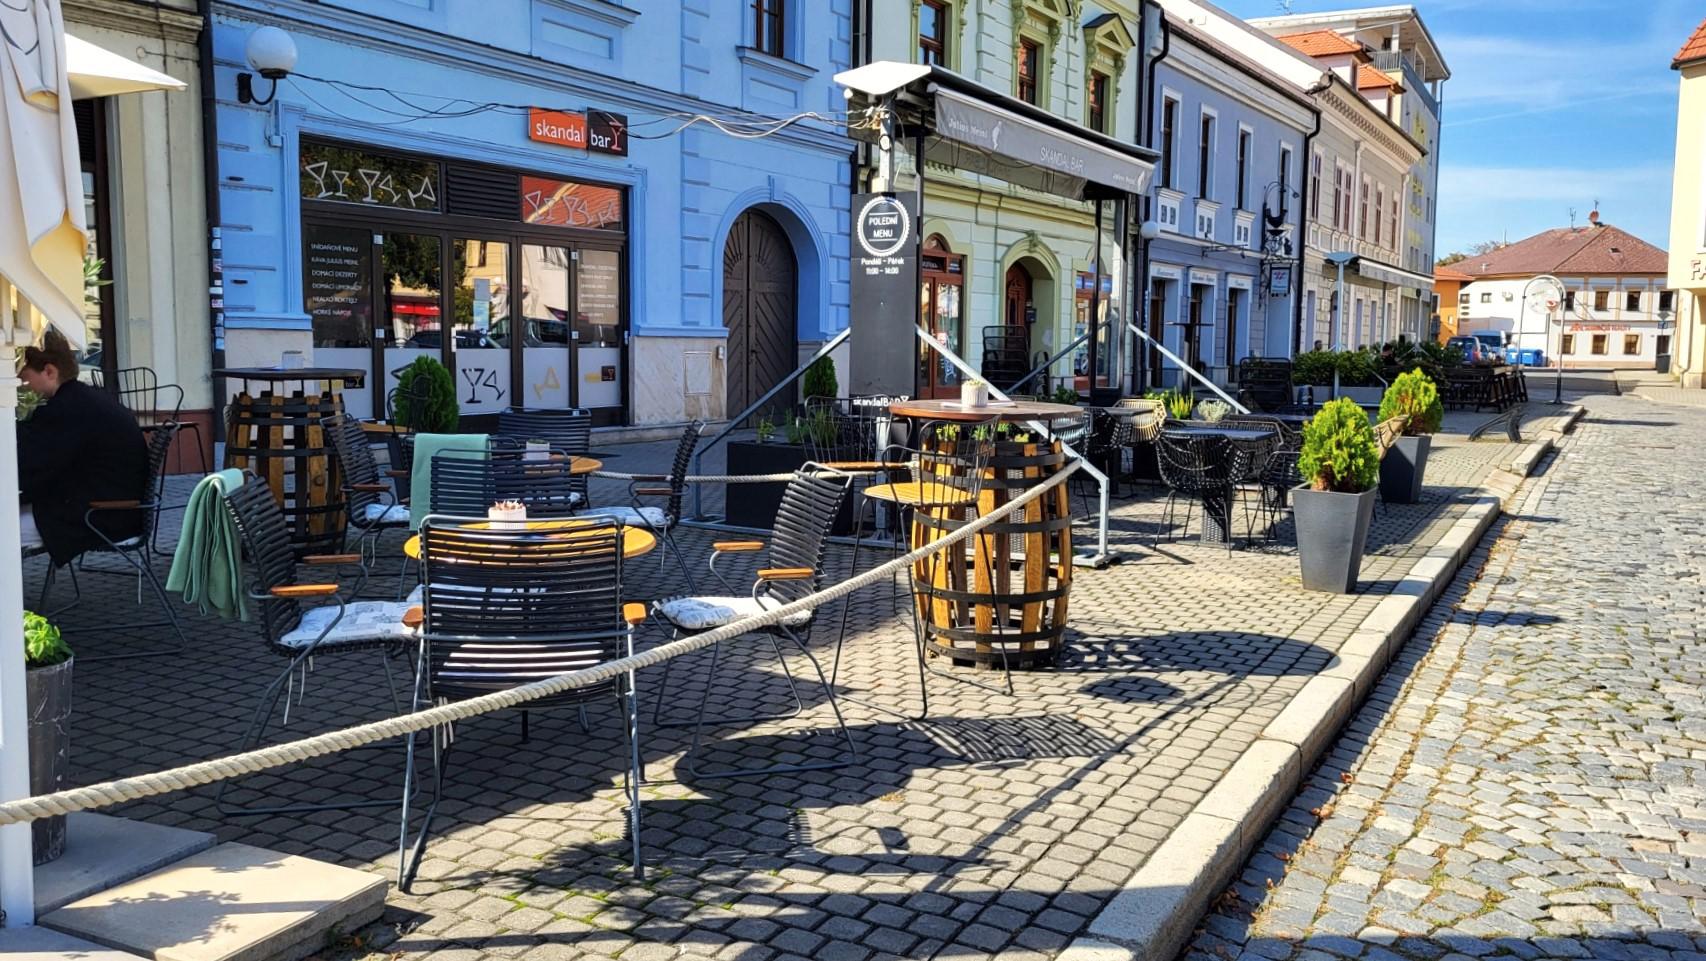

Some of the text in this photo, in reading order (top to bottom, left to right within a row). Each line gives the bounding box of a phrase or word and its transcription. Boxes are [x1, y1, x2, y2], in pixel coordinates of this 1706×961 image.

[948, 117, 969, 133] Julius
[536, 119, 611, 147] skandal bar
[1040, 146, 1084, 172] SKANDAL BAR
[868, 215, 898, 226] POLEDNÍ
[873, 229, 893, 238] MENU
[343, 245, 358, 253] MENU
[311, 269, 334, 277] DOMÁCÍ
